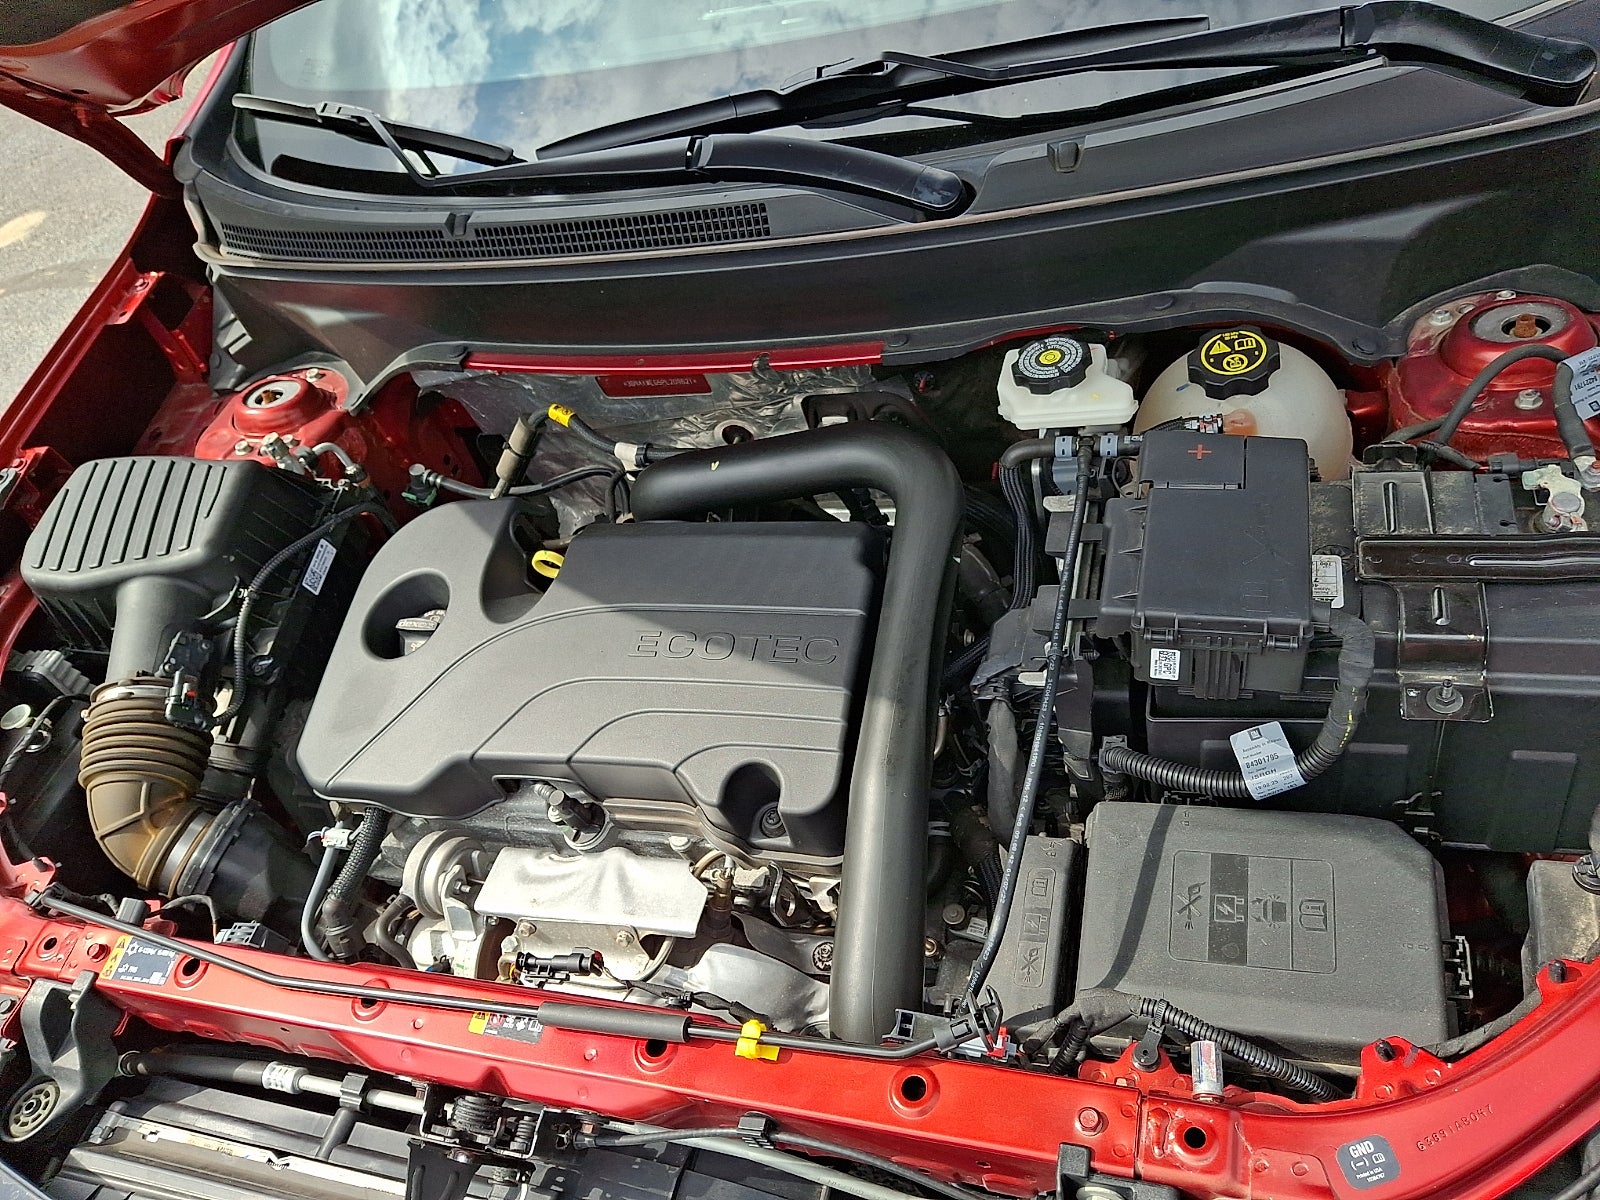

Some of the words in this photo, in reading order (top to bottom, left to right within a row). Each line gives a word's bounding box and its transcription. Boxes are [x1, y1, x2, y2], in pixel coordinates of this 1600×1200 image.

[628, 630, 840, 665] ECOTEC
[1245, 753, 1279, 769] 84301795
[1349, 1140, 1375, 1159] GND
